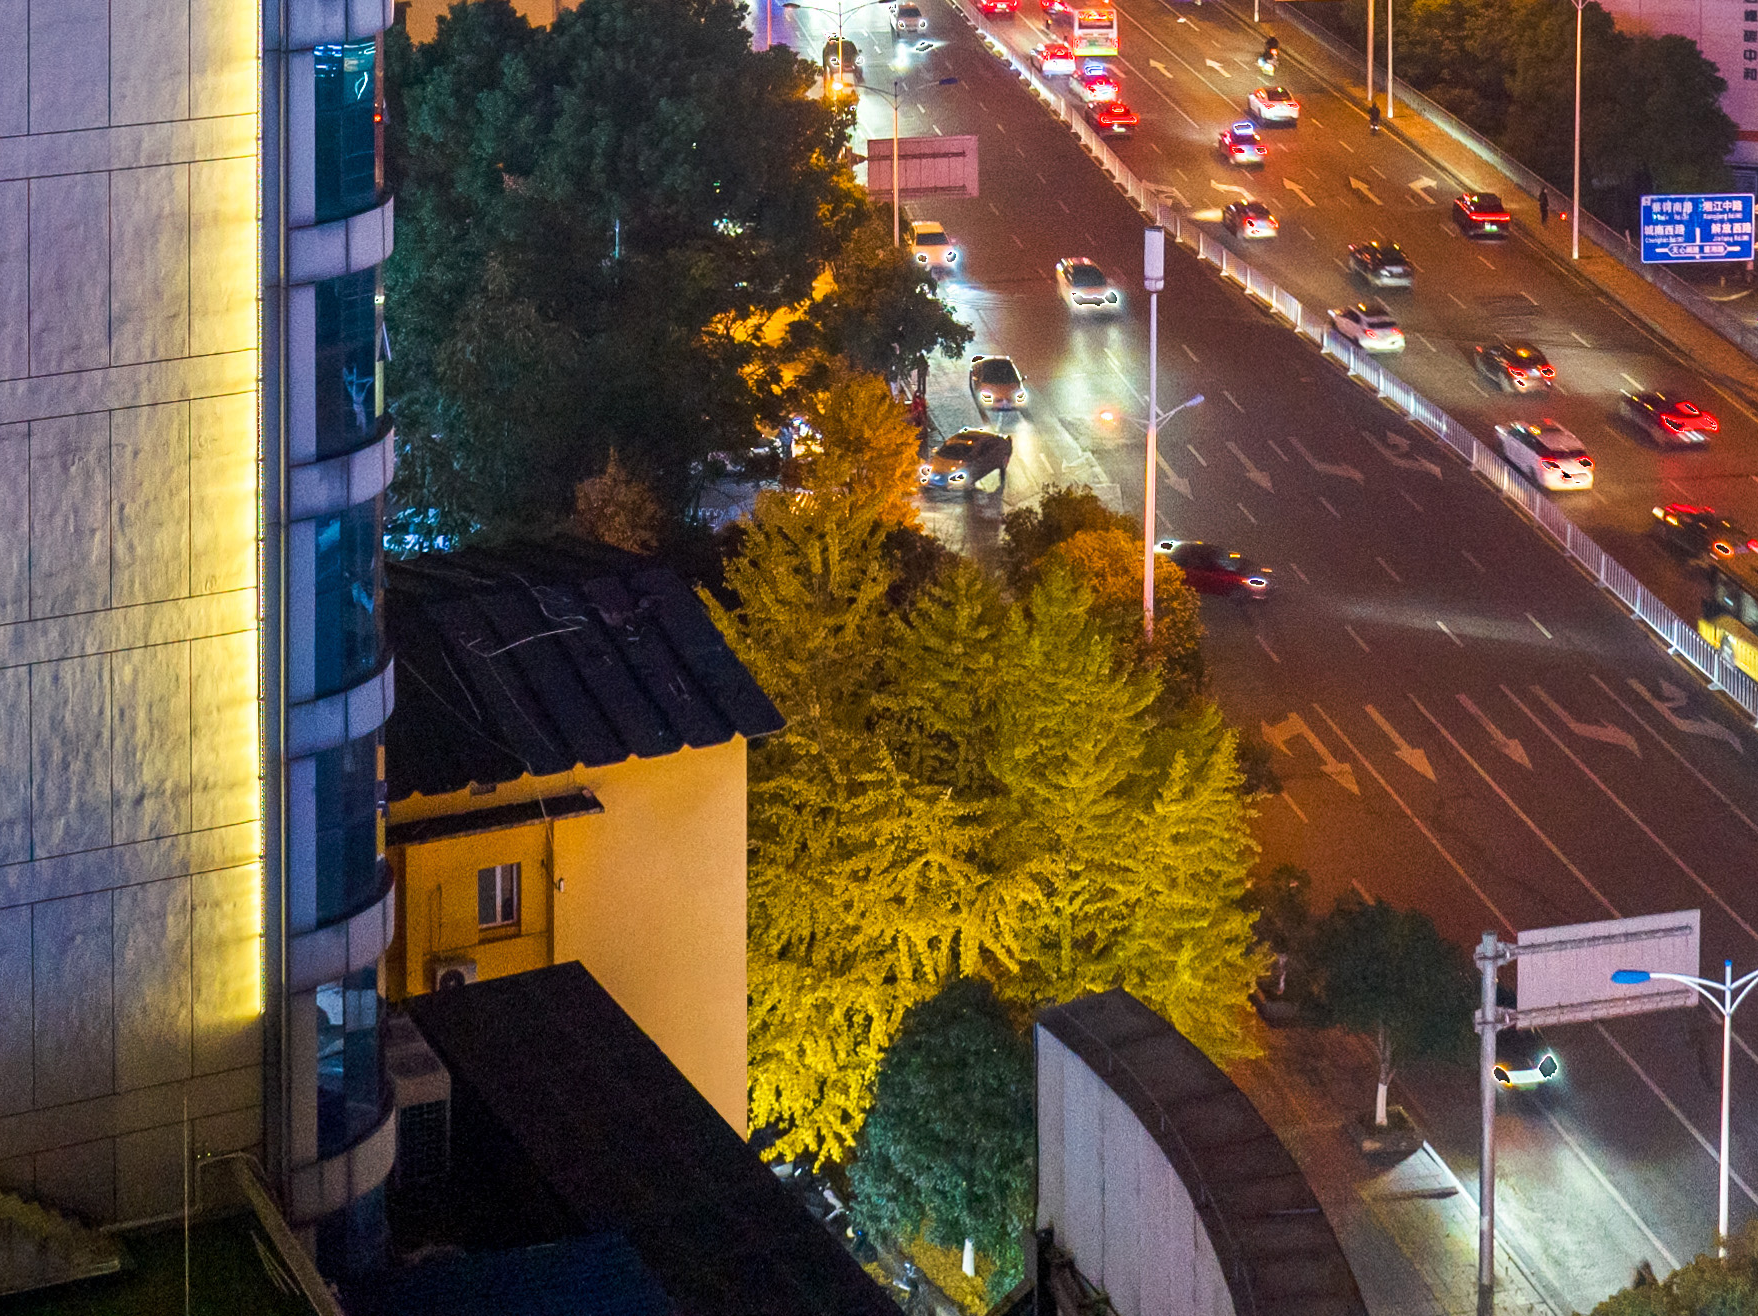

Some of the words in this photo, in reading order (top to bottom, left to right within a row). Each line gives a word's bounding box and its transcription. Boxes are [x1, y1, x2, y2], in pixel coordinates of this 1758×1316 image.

[1644, 224, 1685, 235] 城南西路
[1711, 222, 1751, 234] 解放西路
